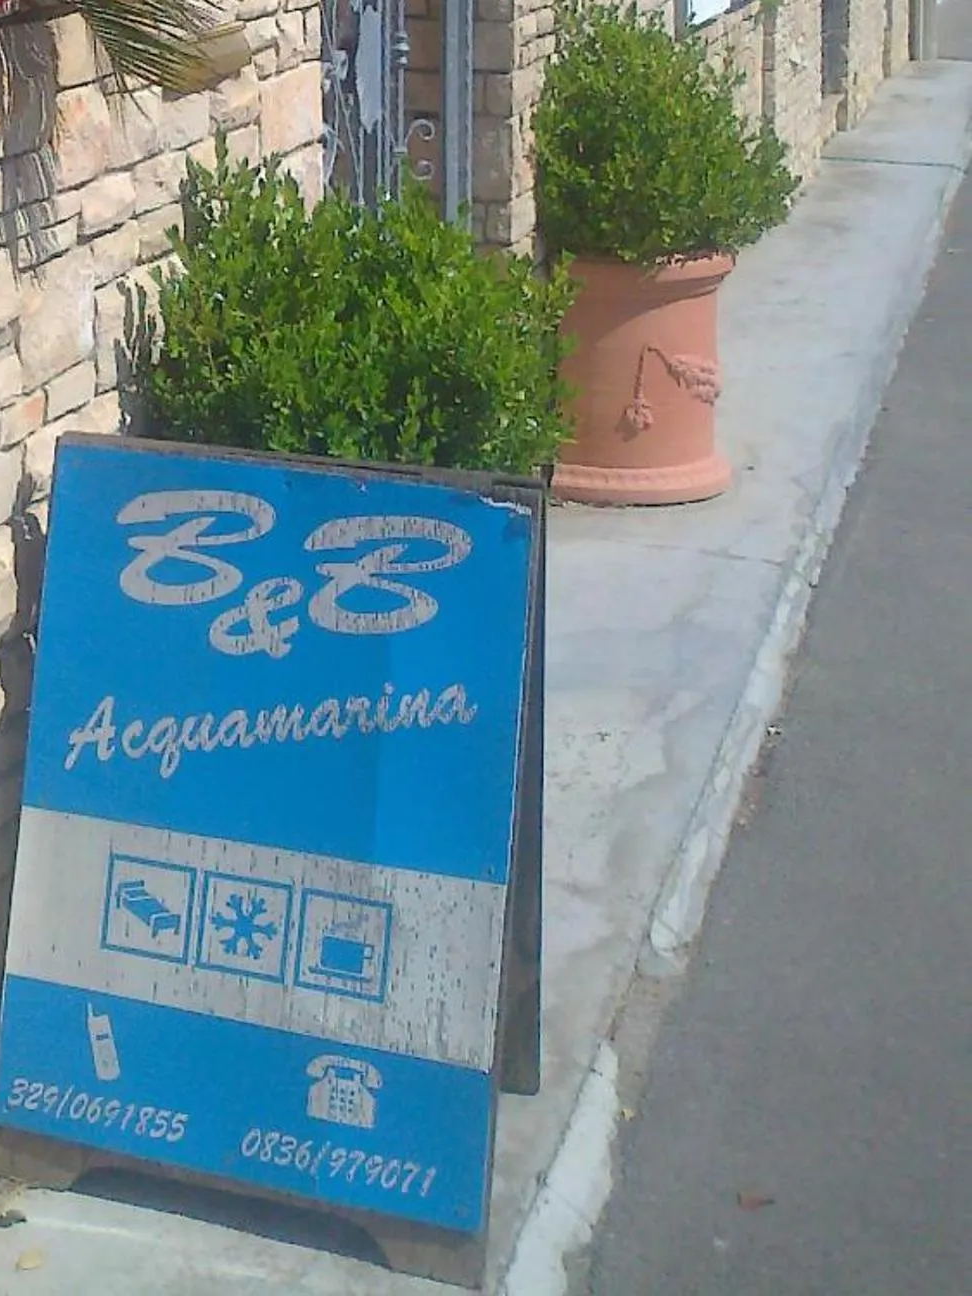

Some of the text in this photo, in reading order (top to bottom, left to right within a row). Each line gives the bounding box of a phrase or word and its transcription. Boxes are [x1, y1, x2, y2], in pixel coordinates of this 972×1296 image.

[64, 681, 479, 779] Acquamarina
[7, 1077, 189, 1143] 329/0691855
[240, 1127, 437, 1198] 0836/979071
